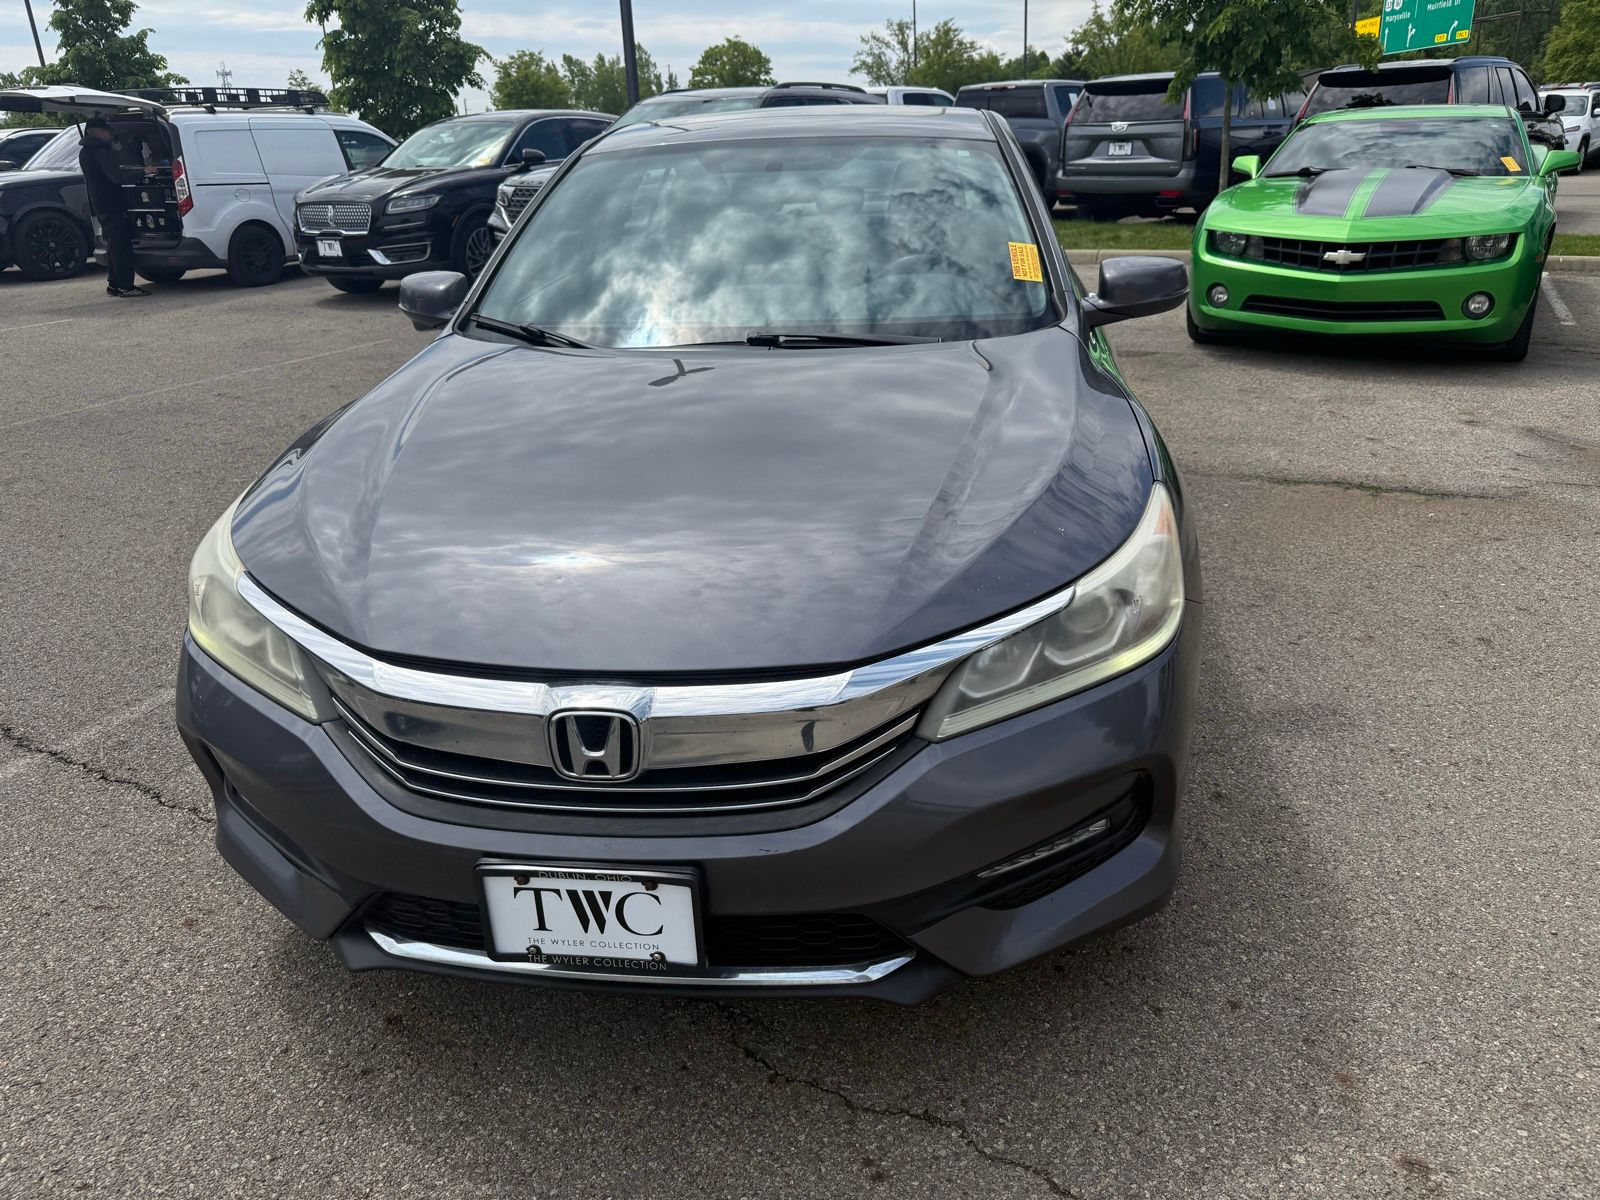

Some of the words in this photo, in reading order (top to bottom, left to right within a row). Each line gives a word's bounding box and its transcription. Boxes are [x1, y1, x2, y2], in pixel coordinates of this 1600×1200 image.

[1427, 0, 1452, 11] Muirfield
[1386, 11, 1410, 22] Marysville
[538, 871, 591, 881] DUBLIN,
[594, 873, 632, 883] OHIO
[513, 886, 664, 937] TWC
[528, 937, 546, 945] THE
[550, 938, 585, 947] WYLER
[590, 940, 660, 951] COLLECTION
[528, 954, 548, 964] THE
[552, 956, 589, 966] WYLER
[594, 957, 667, 970] COLLECTION
